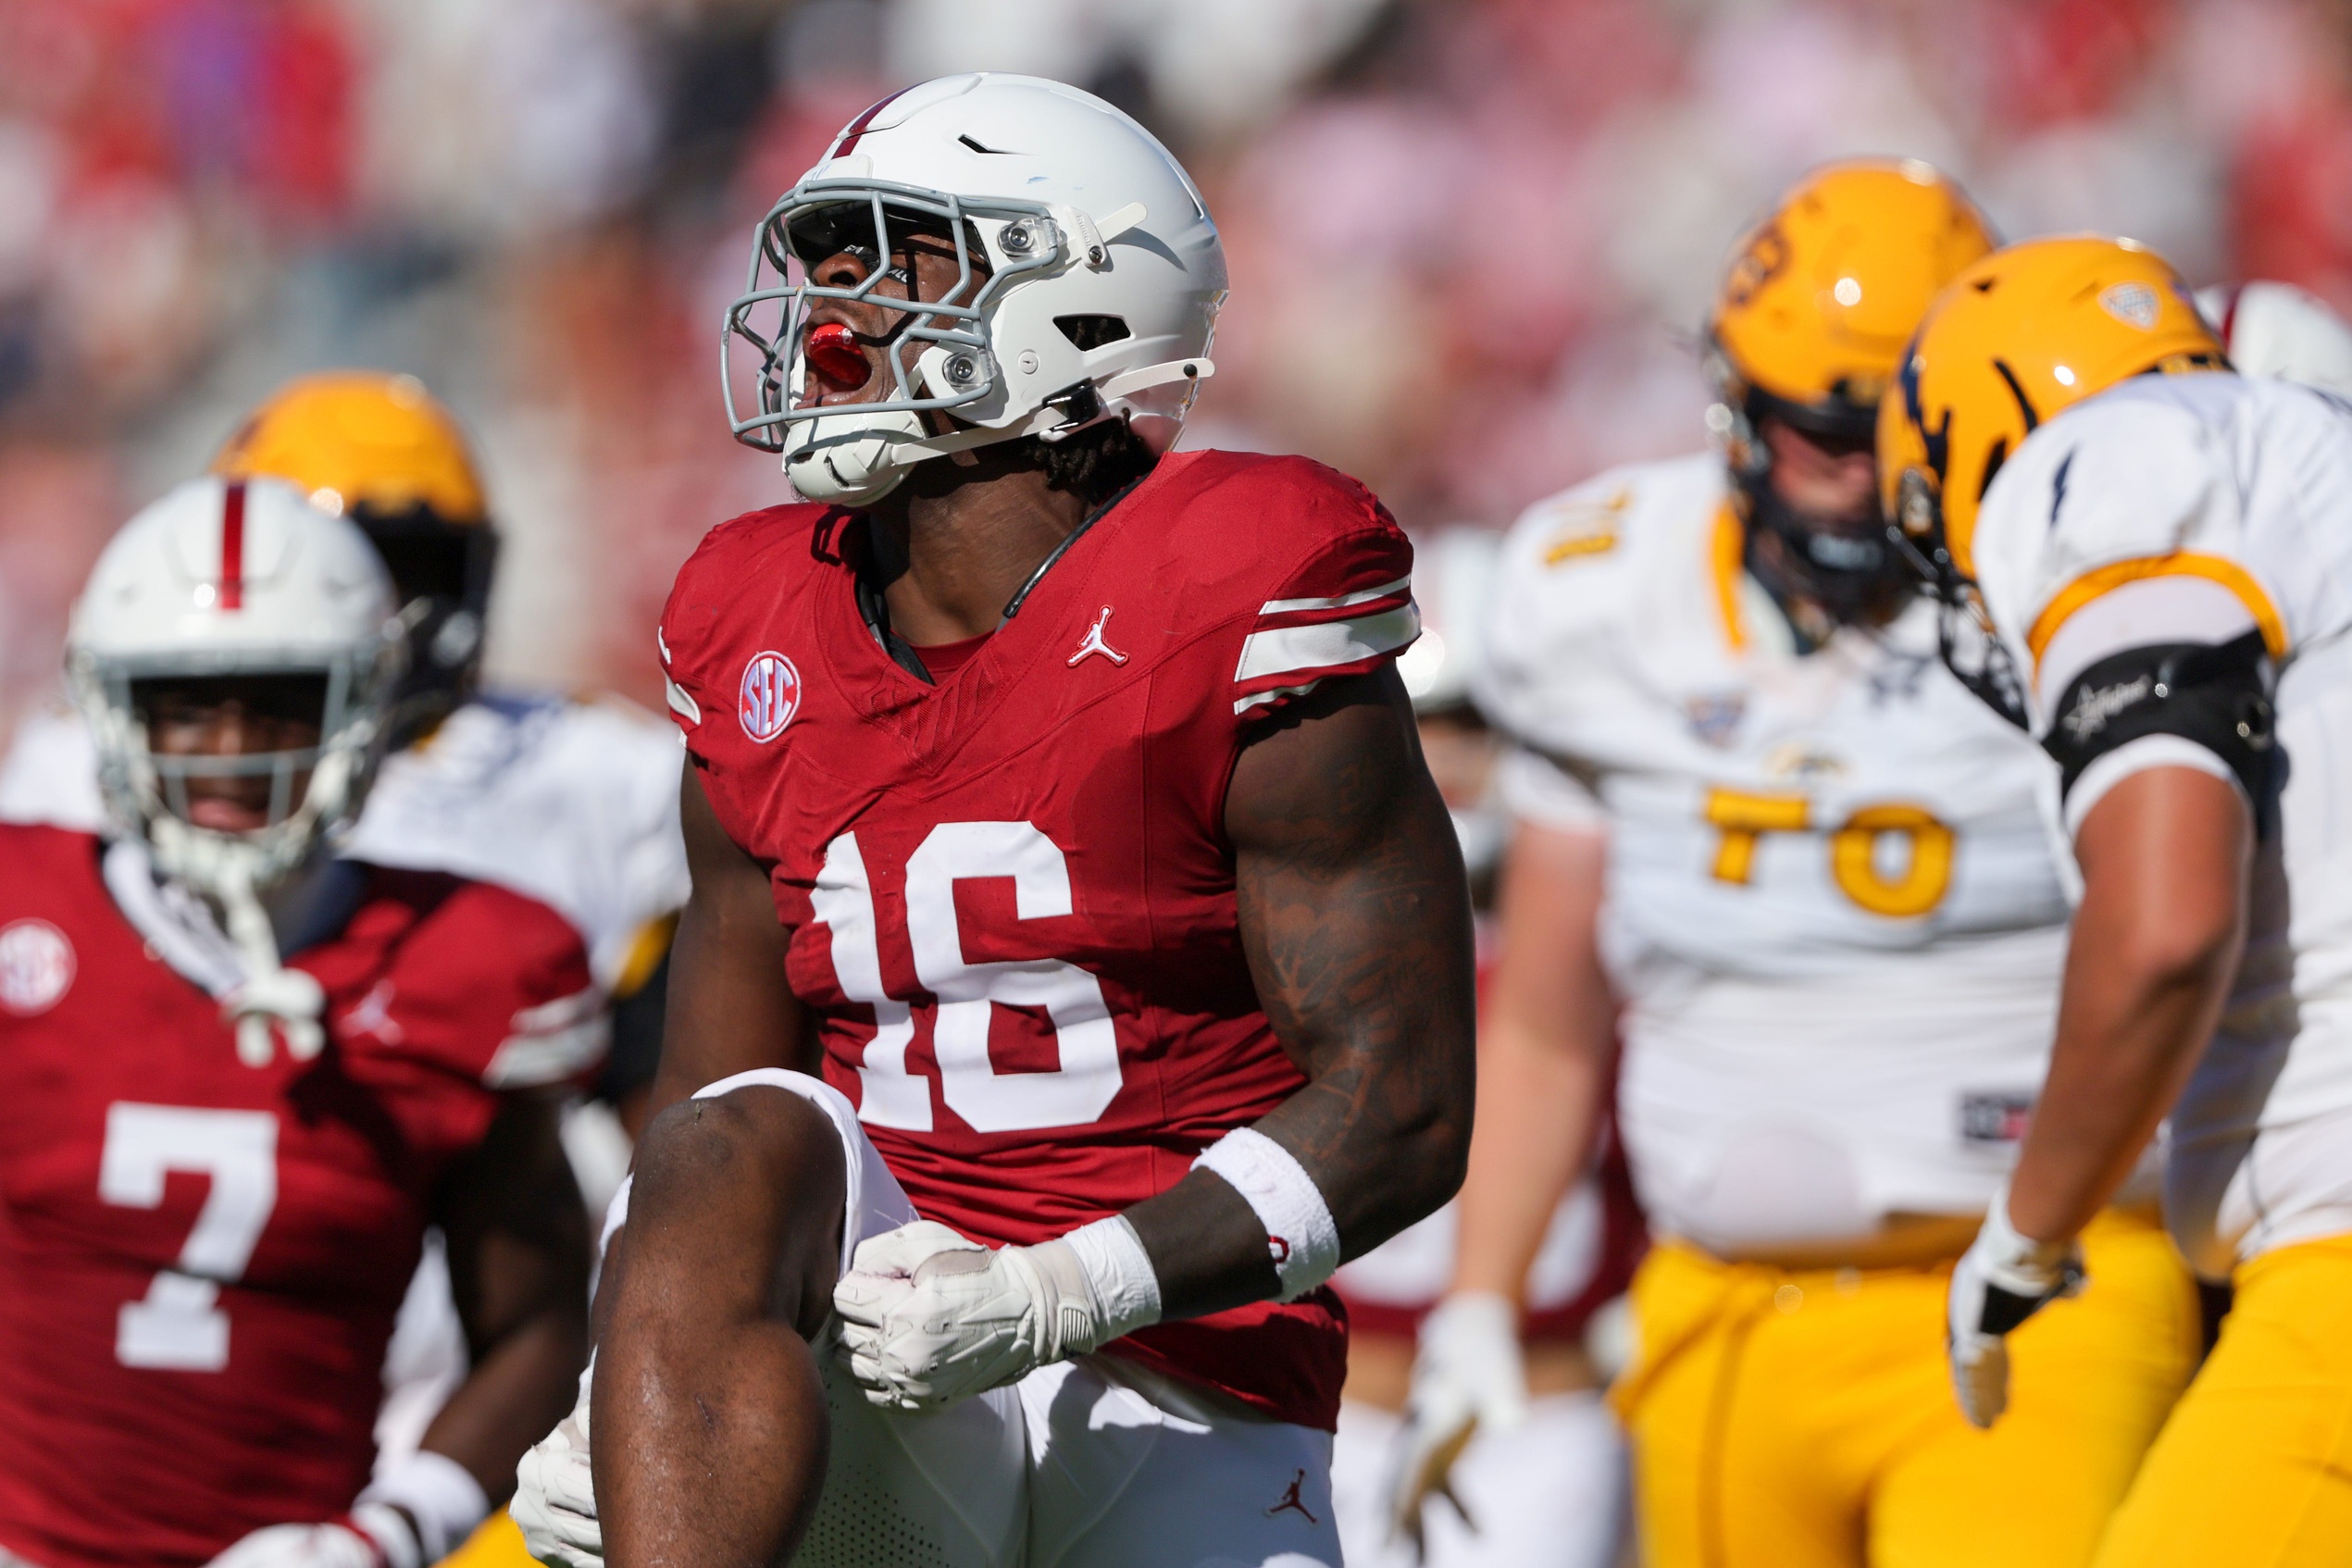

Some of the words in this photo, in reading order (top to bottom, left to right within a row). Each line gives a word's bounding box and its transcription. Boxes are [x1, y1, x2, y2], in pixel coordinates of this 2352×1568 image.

[743, 657, 795, 736] SEC
[808, 820, 1124, 1134] 16
[97, 1101, 280, 1373] 7
